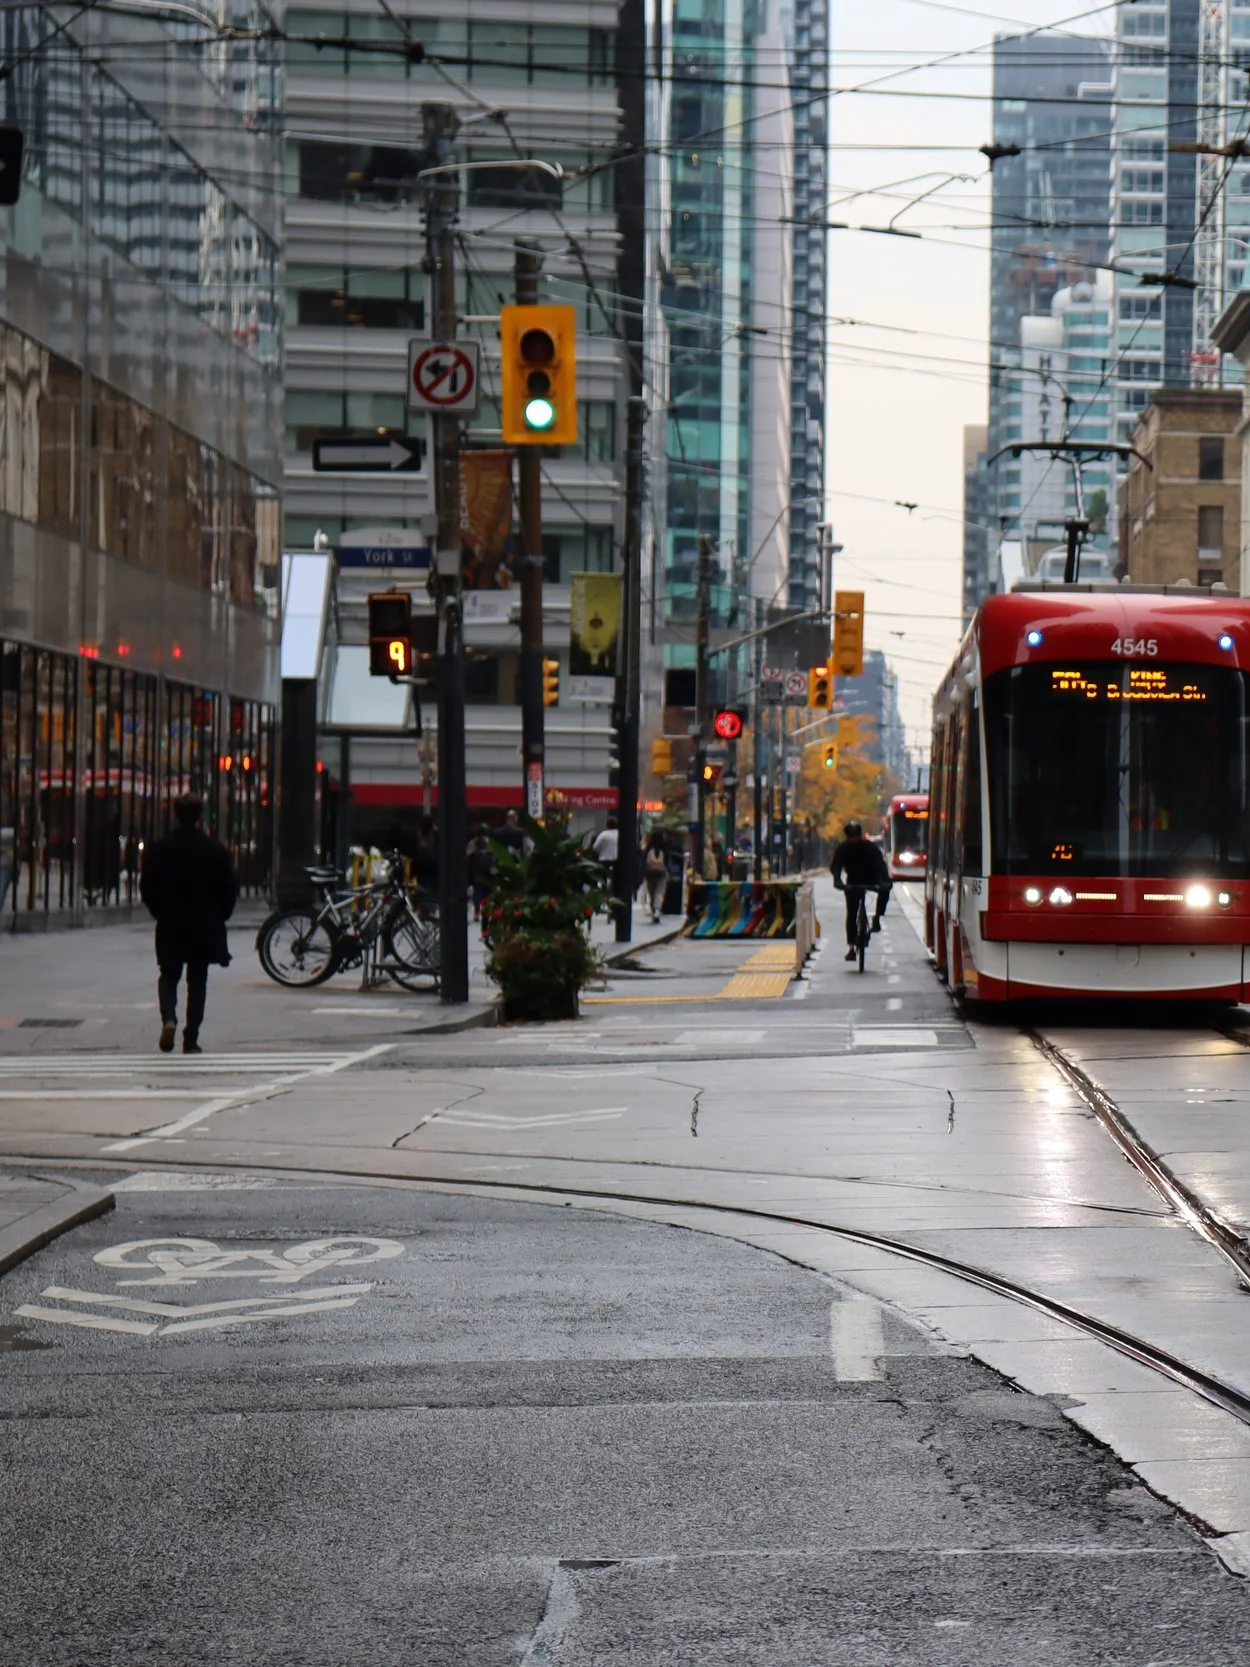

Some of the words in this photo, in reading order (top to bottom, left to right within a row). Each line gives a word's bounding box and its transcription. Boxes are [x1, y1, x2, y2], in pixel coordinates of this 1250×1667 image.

[363, 549, 394, 563] York
[389, 641, 405, 671] 9
[1111, 638, 1158, 656] 4545
